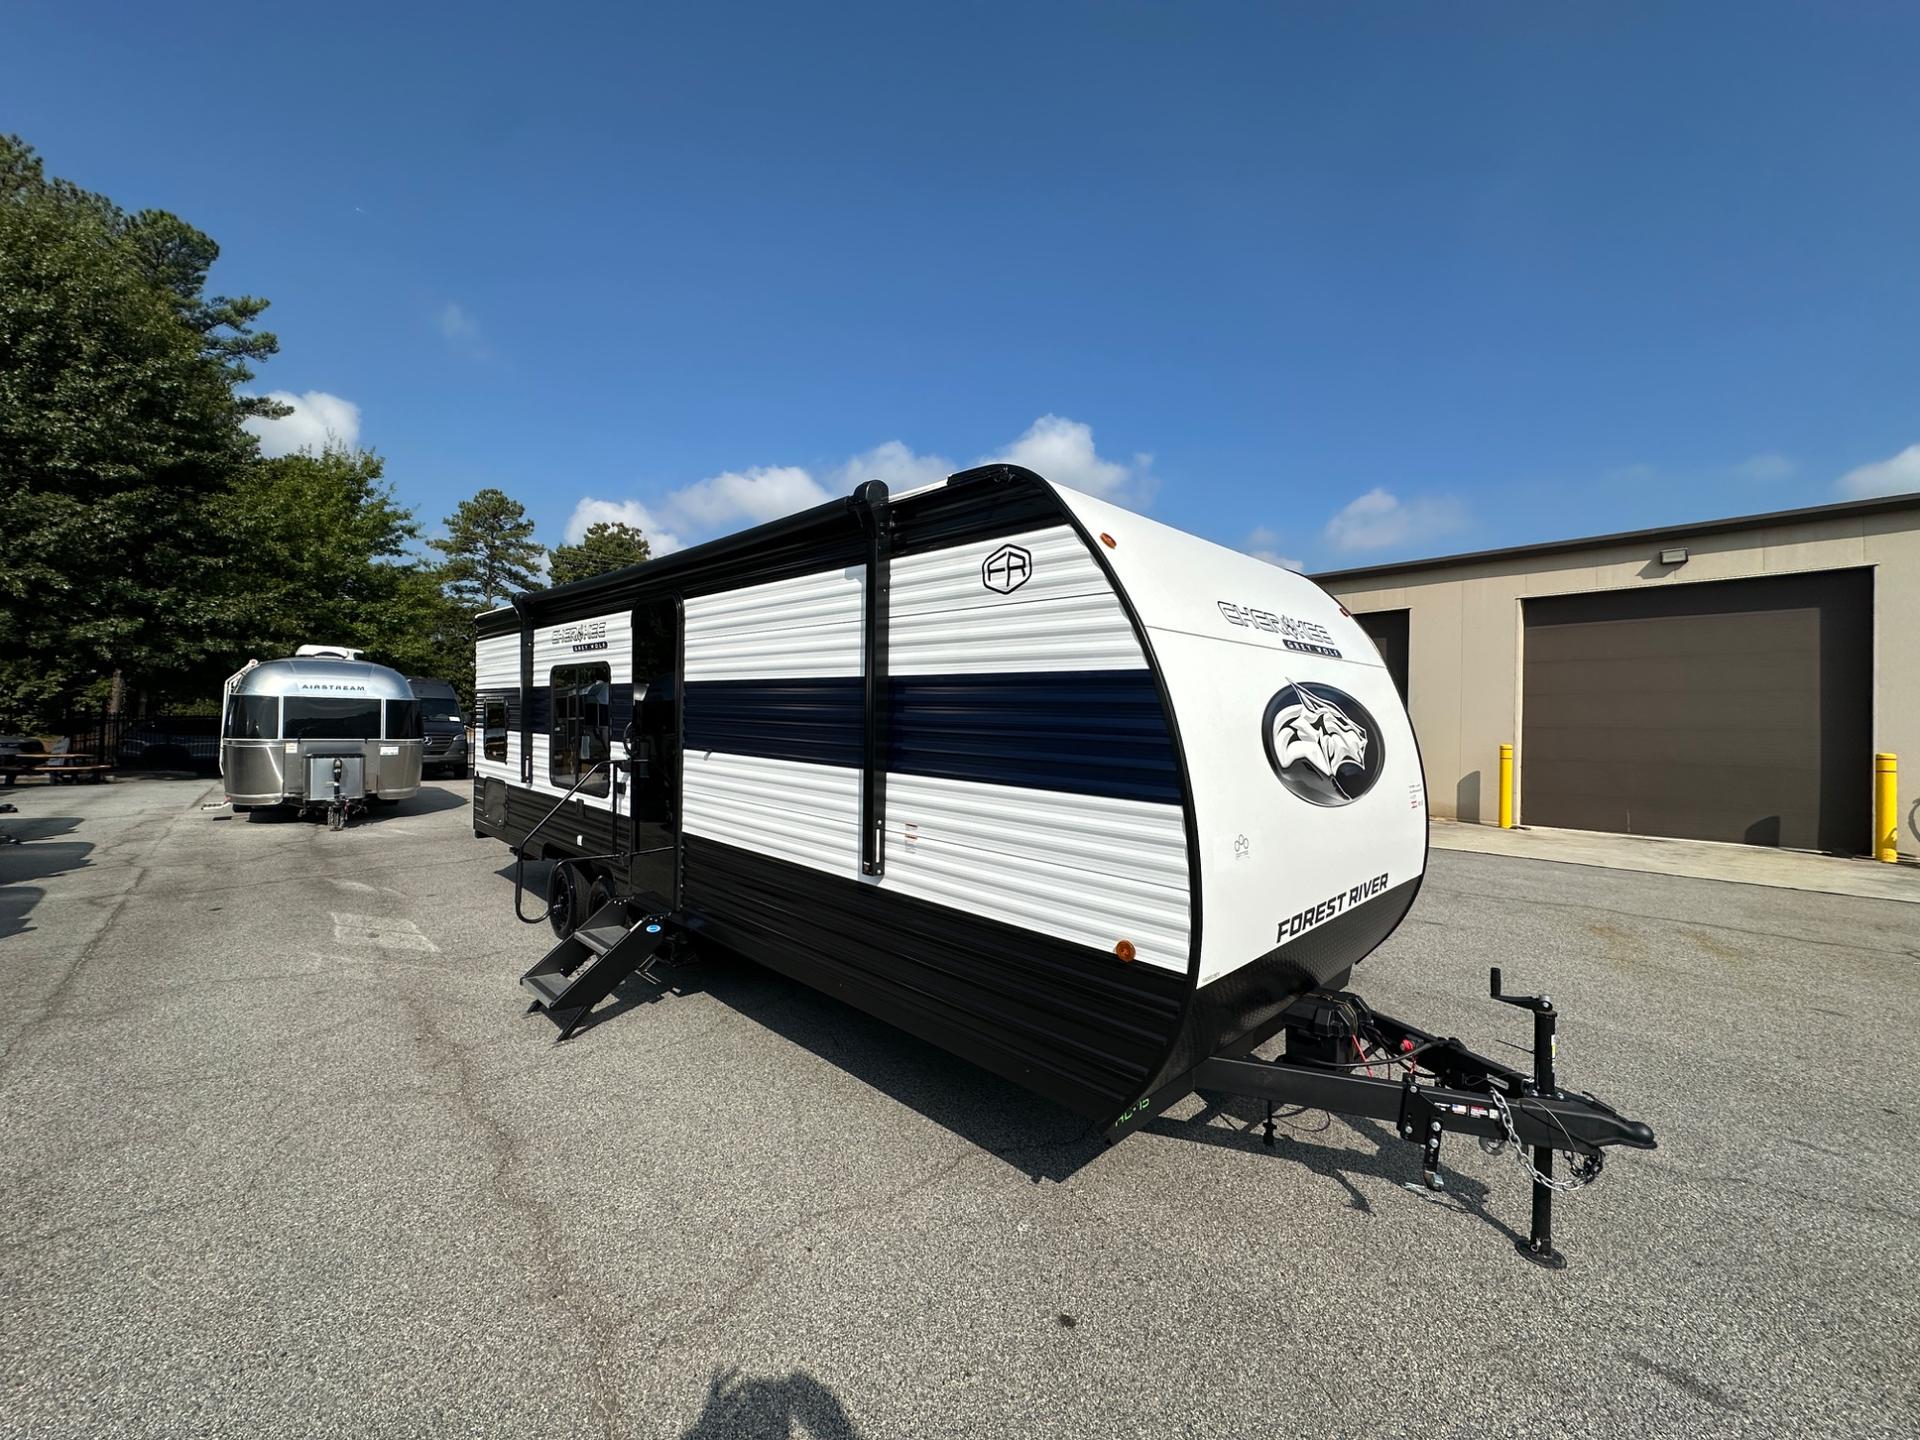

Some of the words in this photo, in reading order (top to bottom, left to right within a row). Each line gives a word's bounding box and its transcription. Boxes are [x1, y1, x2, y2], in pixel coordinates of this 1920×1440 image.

[1216, 600, 1335, 646] CHEROKEE
[302, 683, 365, 691] AIRSTREAM
[1276, 891, 1347, 944] FOREST
[1348, 872, 1389, 907] RIVER
